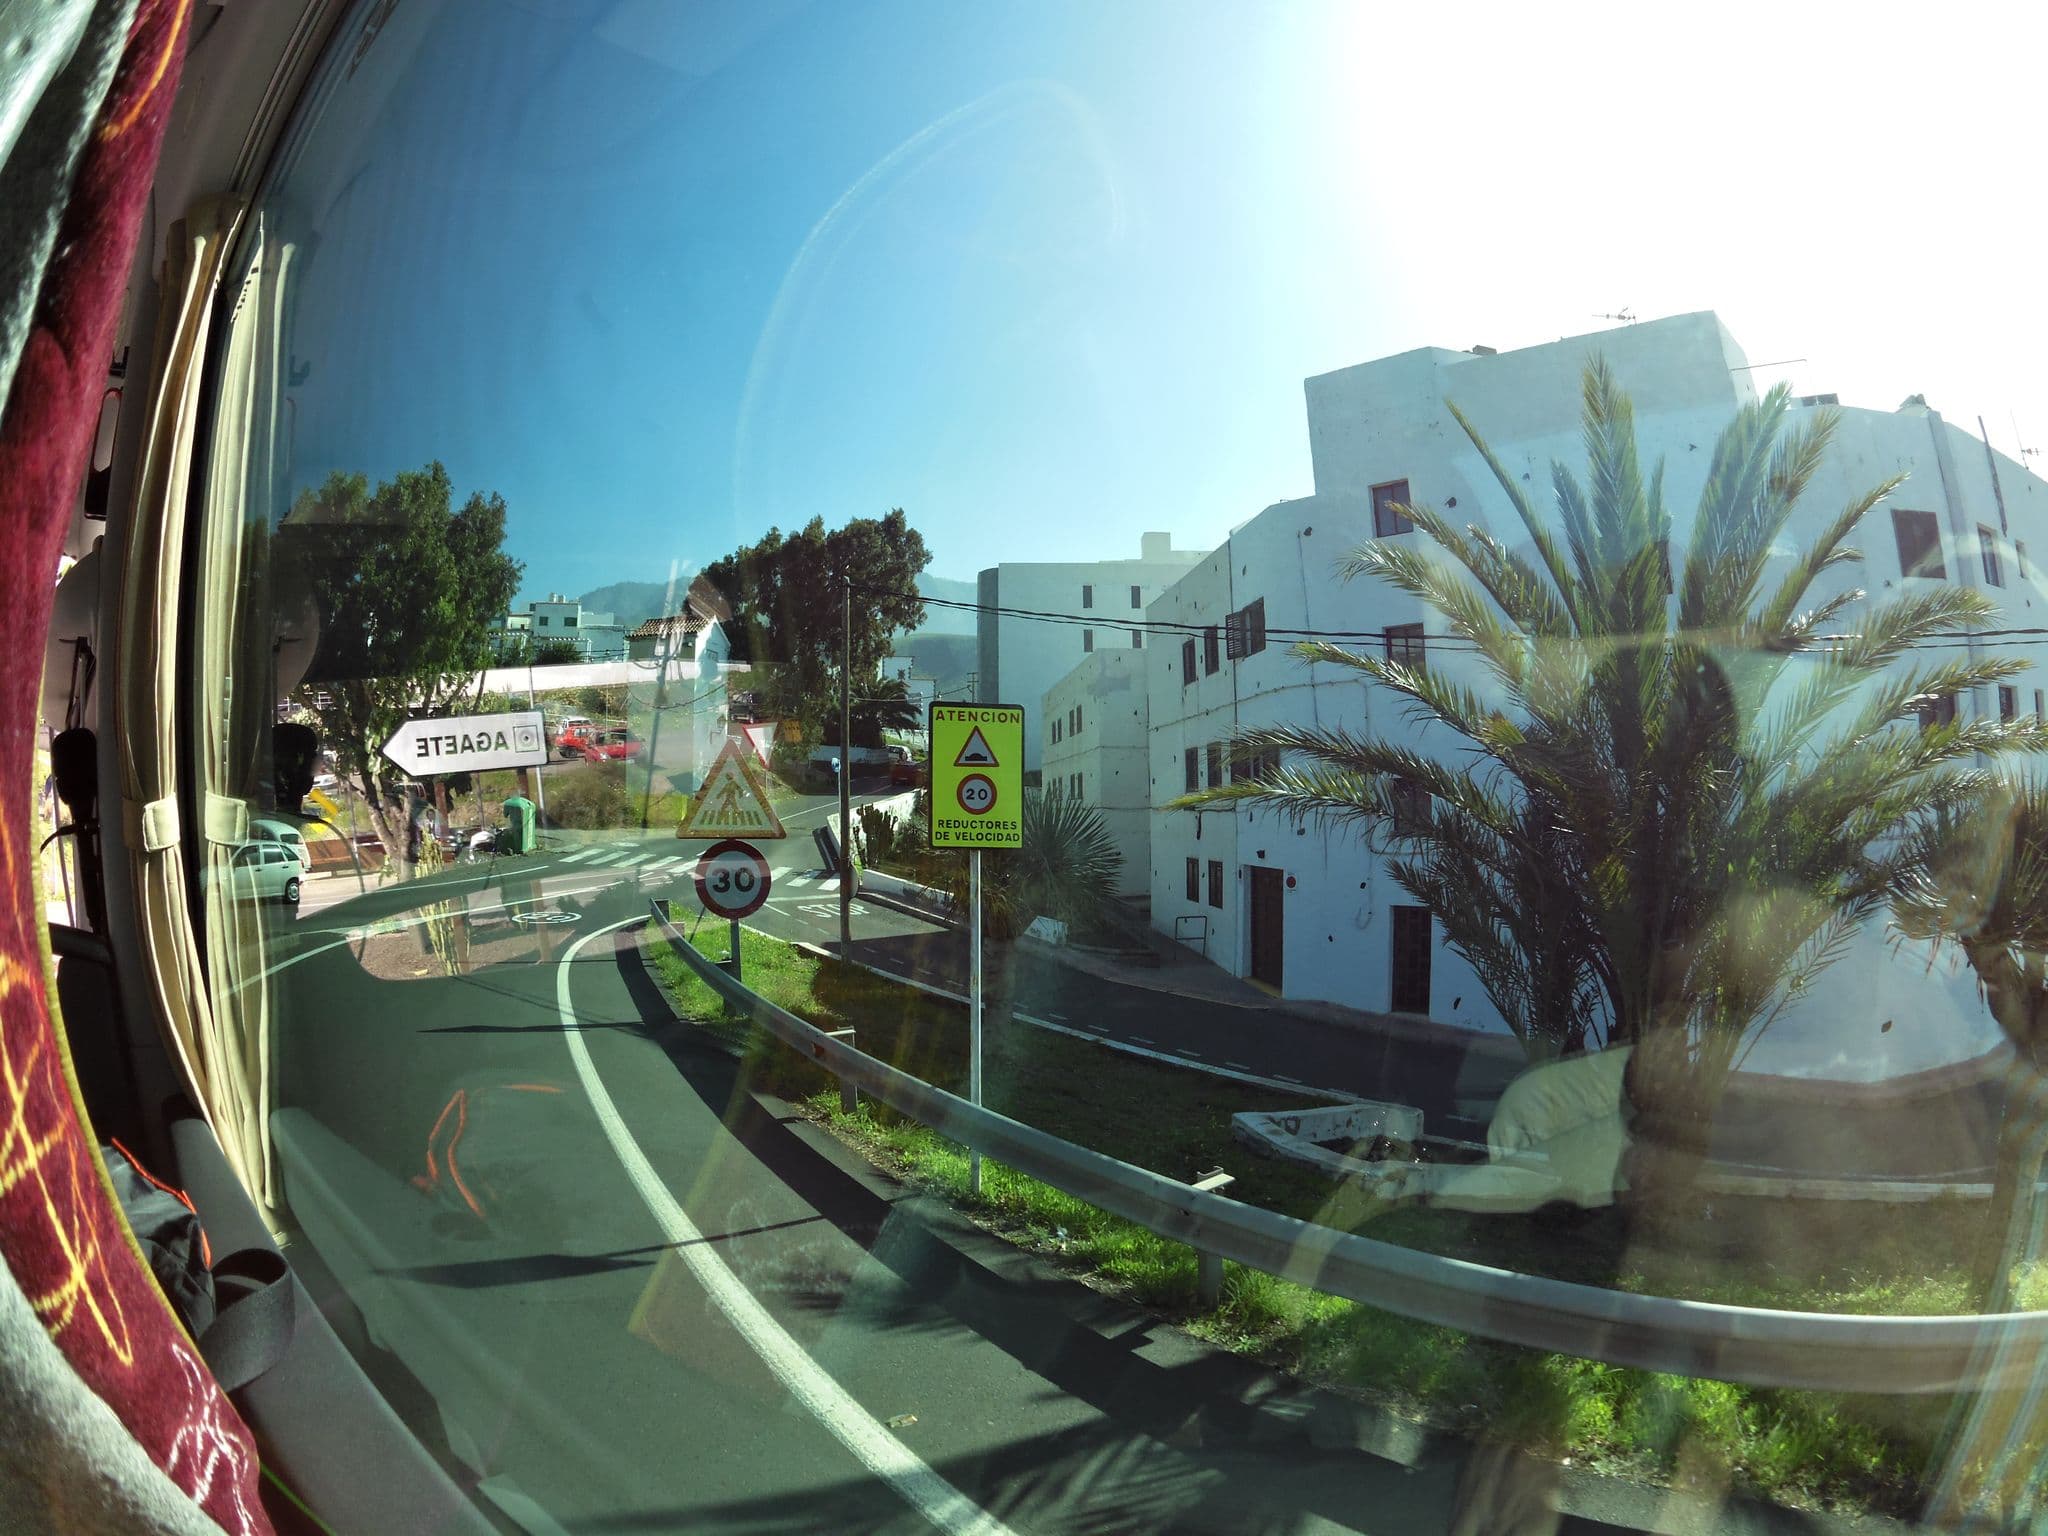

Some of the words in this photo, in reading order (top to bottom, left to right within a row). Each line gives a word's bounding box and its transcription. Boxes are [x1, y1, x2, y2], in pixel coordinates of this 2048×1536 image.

[935, 710, 1020, 724] ATENCION
[965, 788, 988, 801] 20
[937, 819, 1018, 830] REDUCTORES
[935, 831, 950, 841] DE
[955, 831, 1020, 842] VELOCIDAD
[711, 866, 755, 893] 30
